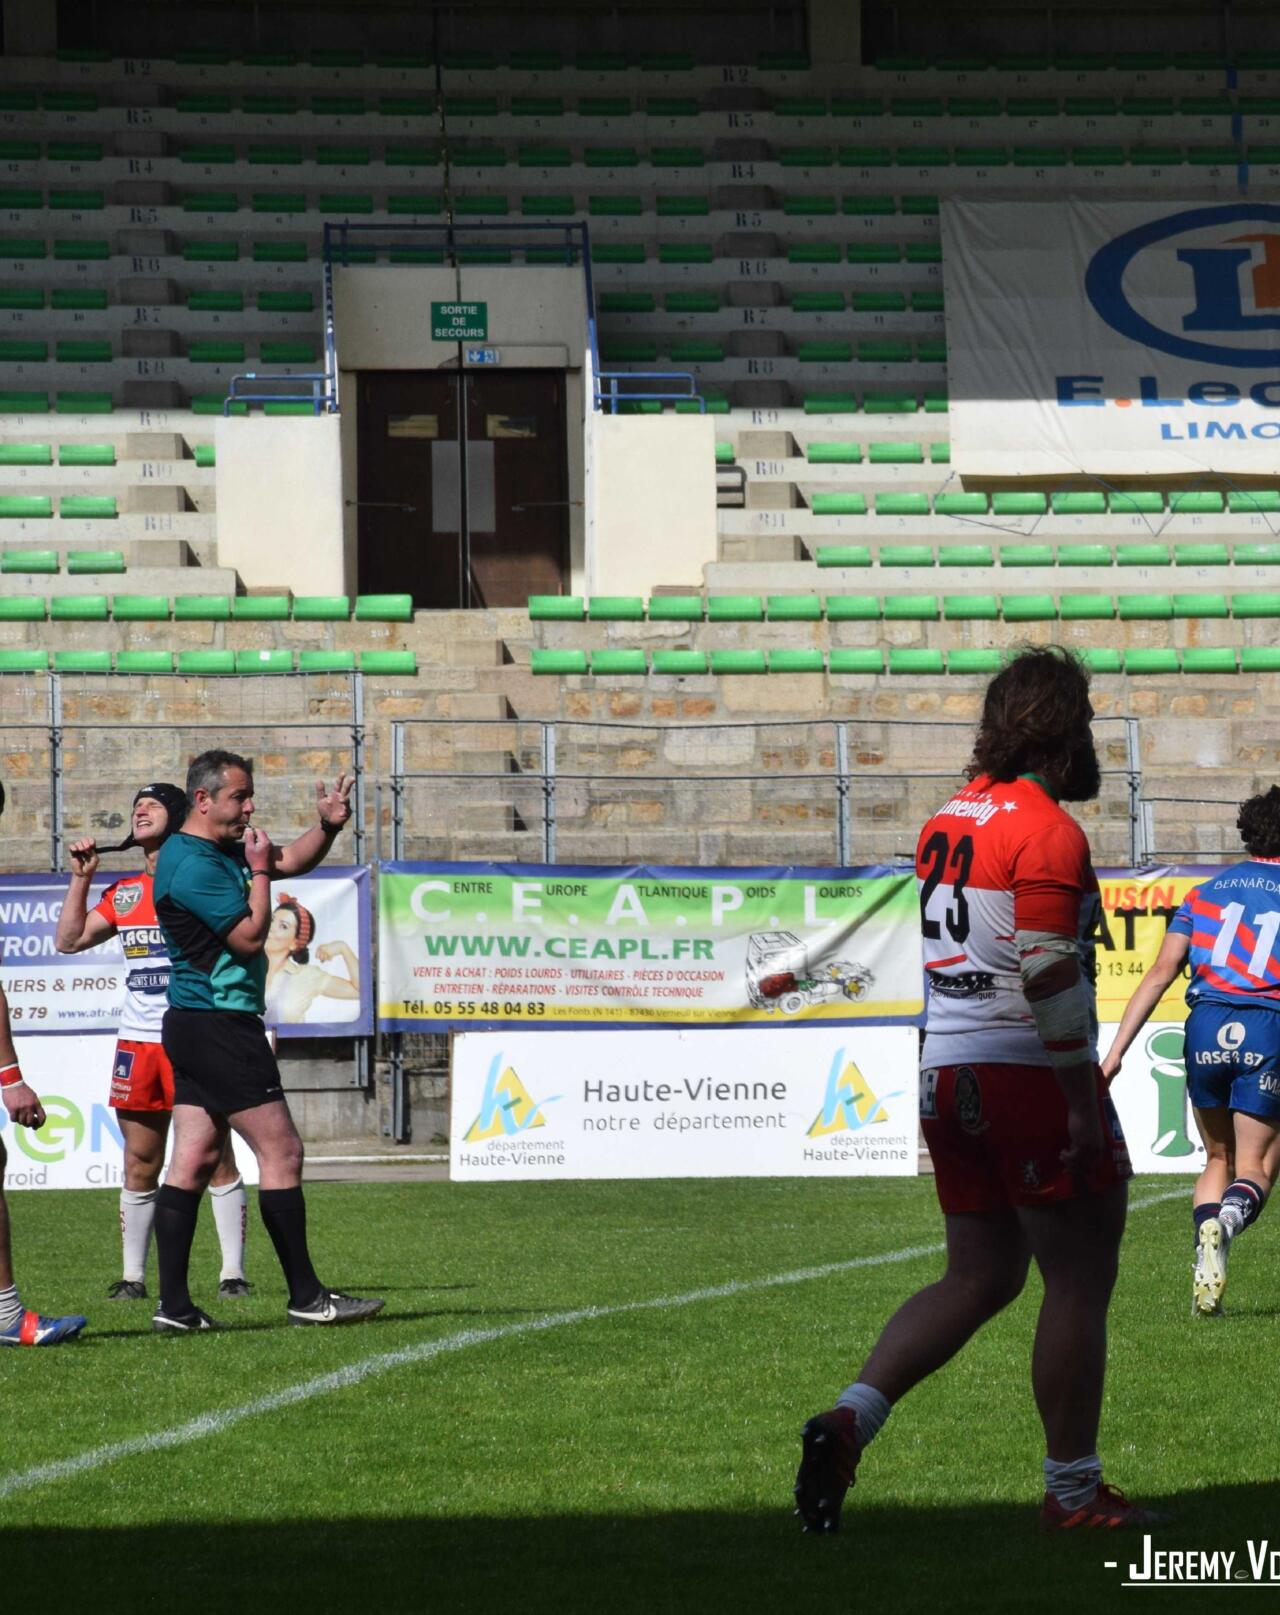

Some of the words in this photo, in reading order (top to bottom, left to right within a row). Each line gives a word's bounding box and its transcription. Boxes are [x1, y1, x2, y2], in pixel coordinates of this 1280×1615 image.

[440, 306, 478, 315] SORTIE
[452, 317, 466, 326] DE
[435, 328, 485, 337] SECOURS
[920, 831, 974, 944] 23
[424, 935, 714, 960] WWW.CEAPL.FR
[413, 966, 442, 978] VENTE
[445, 968, 450, 977] &
[455, 968, 486, 978] ACHAT
[494, 968, 522, 978] POIDS
[525, 968, 562, 978] LOURDS
[571, 969, 624, 980] UTILITAIRES
[666, 970, 725, 982] D'OCCASION
[1108, 962, 1123, 976] 13
[1128, 962, 1144, 975] 44
[53, 978, 65, 992] &
[72, 977, 118, 991] PROS
[434, 984, 484, 994] ENTRETIEN
[492, 982, 556, 996] RÉPARATIONS
[566, 984, 598, 996] VISITES
[602, 984, 648, 997] CONTRÔLE
[652, 986, 704, 998] TECHNIQUE
[29, 1006, 48, 1018] 79
[404, 1000, 428, 1014] Tél.
[434, 1002, 452, 1014] 05
[458, 1002, 476, 1014] 55
[481, 1002, 499, 1014] 48
[504, 1002, 522, 1015] 04
[528, 1002, 546, 1015] 83
[1195, 1051, 1240, 1064] LASER
[1244, 1052, 1264, 1066] 87
[584, 1078, 787, 1102] Haute-Vienne
[584, 1112, 640, 1131] notre
[654, 1111, 786, 1134] département
[460, 1152, 565, 1166] Haute-Vienne
[804, 1148, 908, 1162] Haute-Vienne
[86, 1163, 124, 1184] Cli
